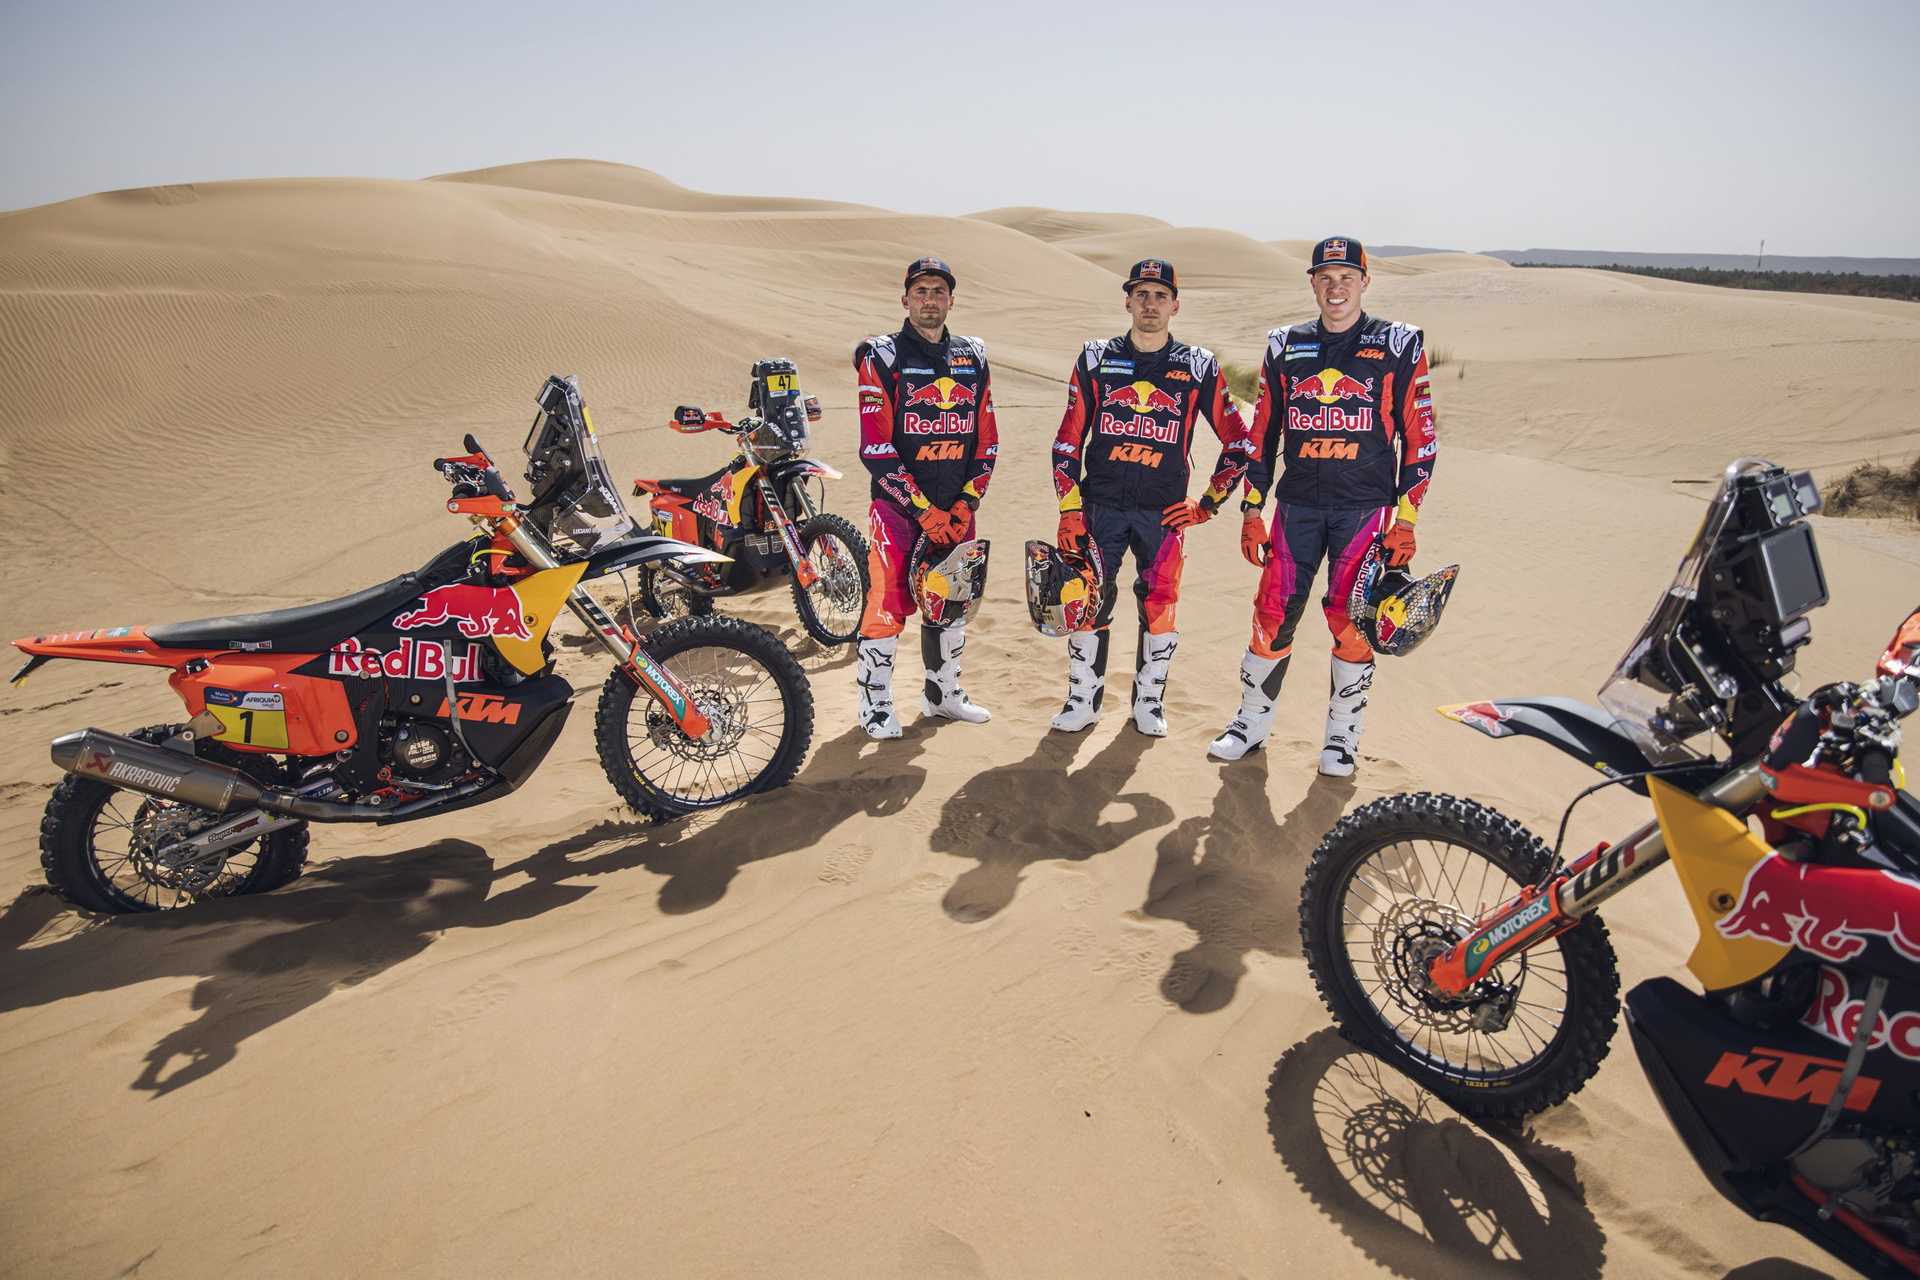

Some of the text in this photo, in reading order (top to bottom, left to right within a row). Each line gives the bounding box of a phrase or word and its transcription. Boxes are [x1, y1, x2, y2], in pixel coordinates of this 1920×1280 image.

[951, 357, 973, 366] KTM
[1355, 348, 1386, 360] KTM
[778, 375, 791, 390] 47
[1165, 369, 1191, 382] KTM
[904, 411, 974, 434] Red Bull
[1100, 413, 1180, 443] Red Bull
[1288, 406, 1374, 431] Red Bull
[915, 441, 965, 461] KTM
[1108, 442, 1164, 468] KTM
[1298, 438, 1360, 460] KTM
[214, 690, 231, 699] Maroc
[645, 664, 683, 706] MOTOREX
[210, 694, 231, 702] Telecom
[245, 696, 275, 704] AFRIQUIA
[436, 692, 522, 725] KTM
[239, 711, 254, 744] 1
[1488, 898, 1549, 946] MOTOREX
[1704, 1046, 1882, 1113] KTM
